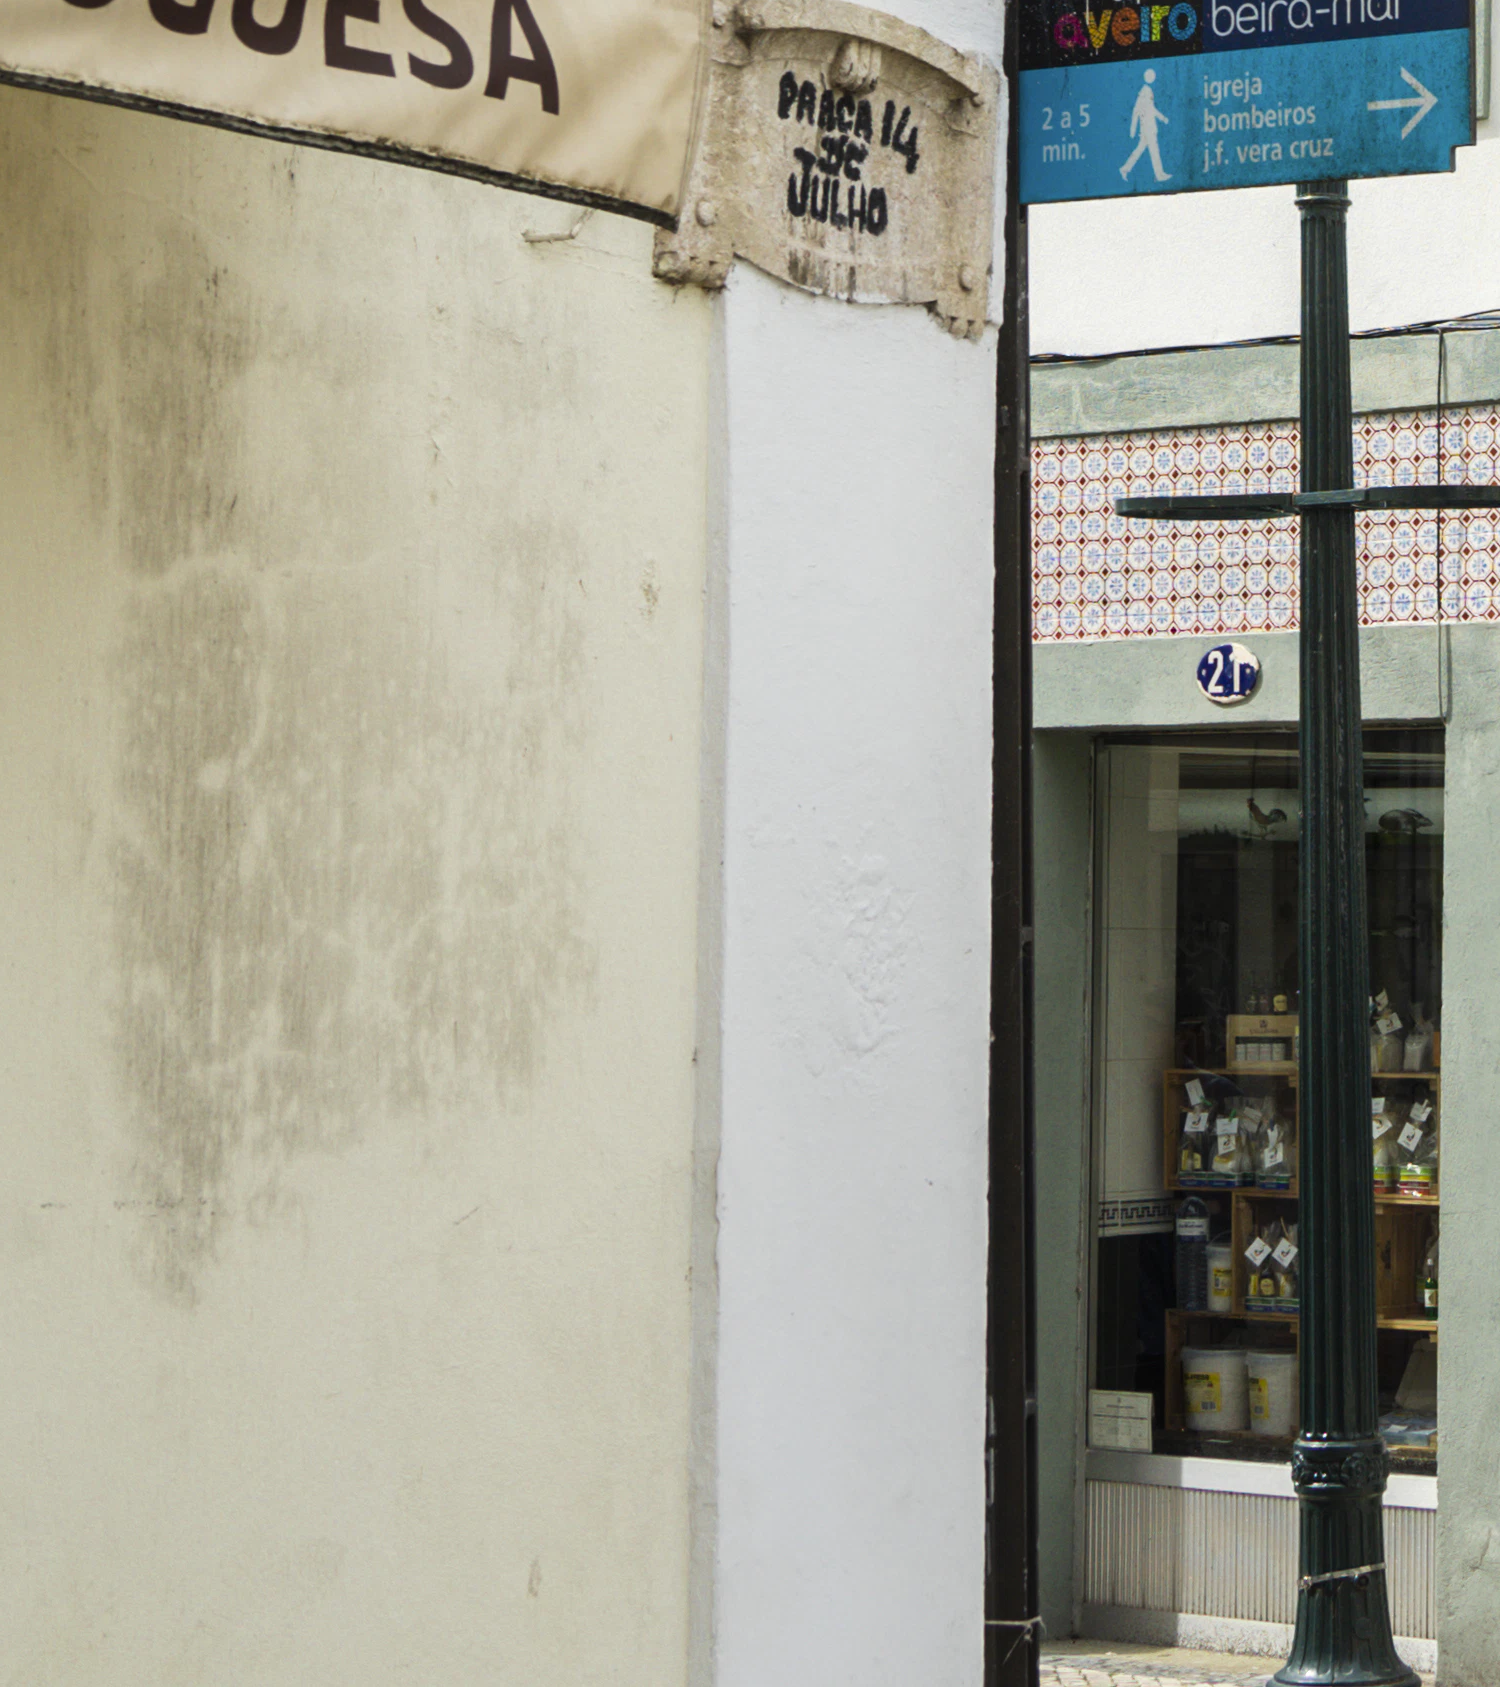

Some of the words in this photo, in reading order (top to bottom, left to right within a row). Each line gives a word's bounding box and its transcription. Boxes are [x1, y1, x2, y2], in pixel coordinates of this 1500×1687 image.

[1053, 1, 1198, 50] aveiro
[1202, 74, 1263, 106] igreja
[1041, 108, 1054, 131] 2
[1060, 111, 1072, 129] a
[1079, 103, 1091, 128] 5
[1202, 102, 1317, 134] bombeiros
[880, 99, 921, 175] 14
[1041, 140, 1086, 163] min.
[1202, 143, 1230, 172] j.f.
[1236, 142, 1285, 165] vera
[1289, 135, 1334, 160] cruz
[787, 147, 889, 237] JULHO
[1206, 649, 1242, 695] 21
